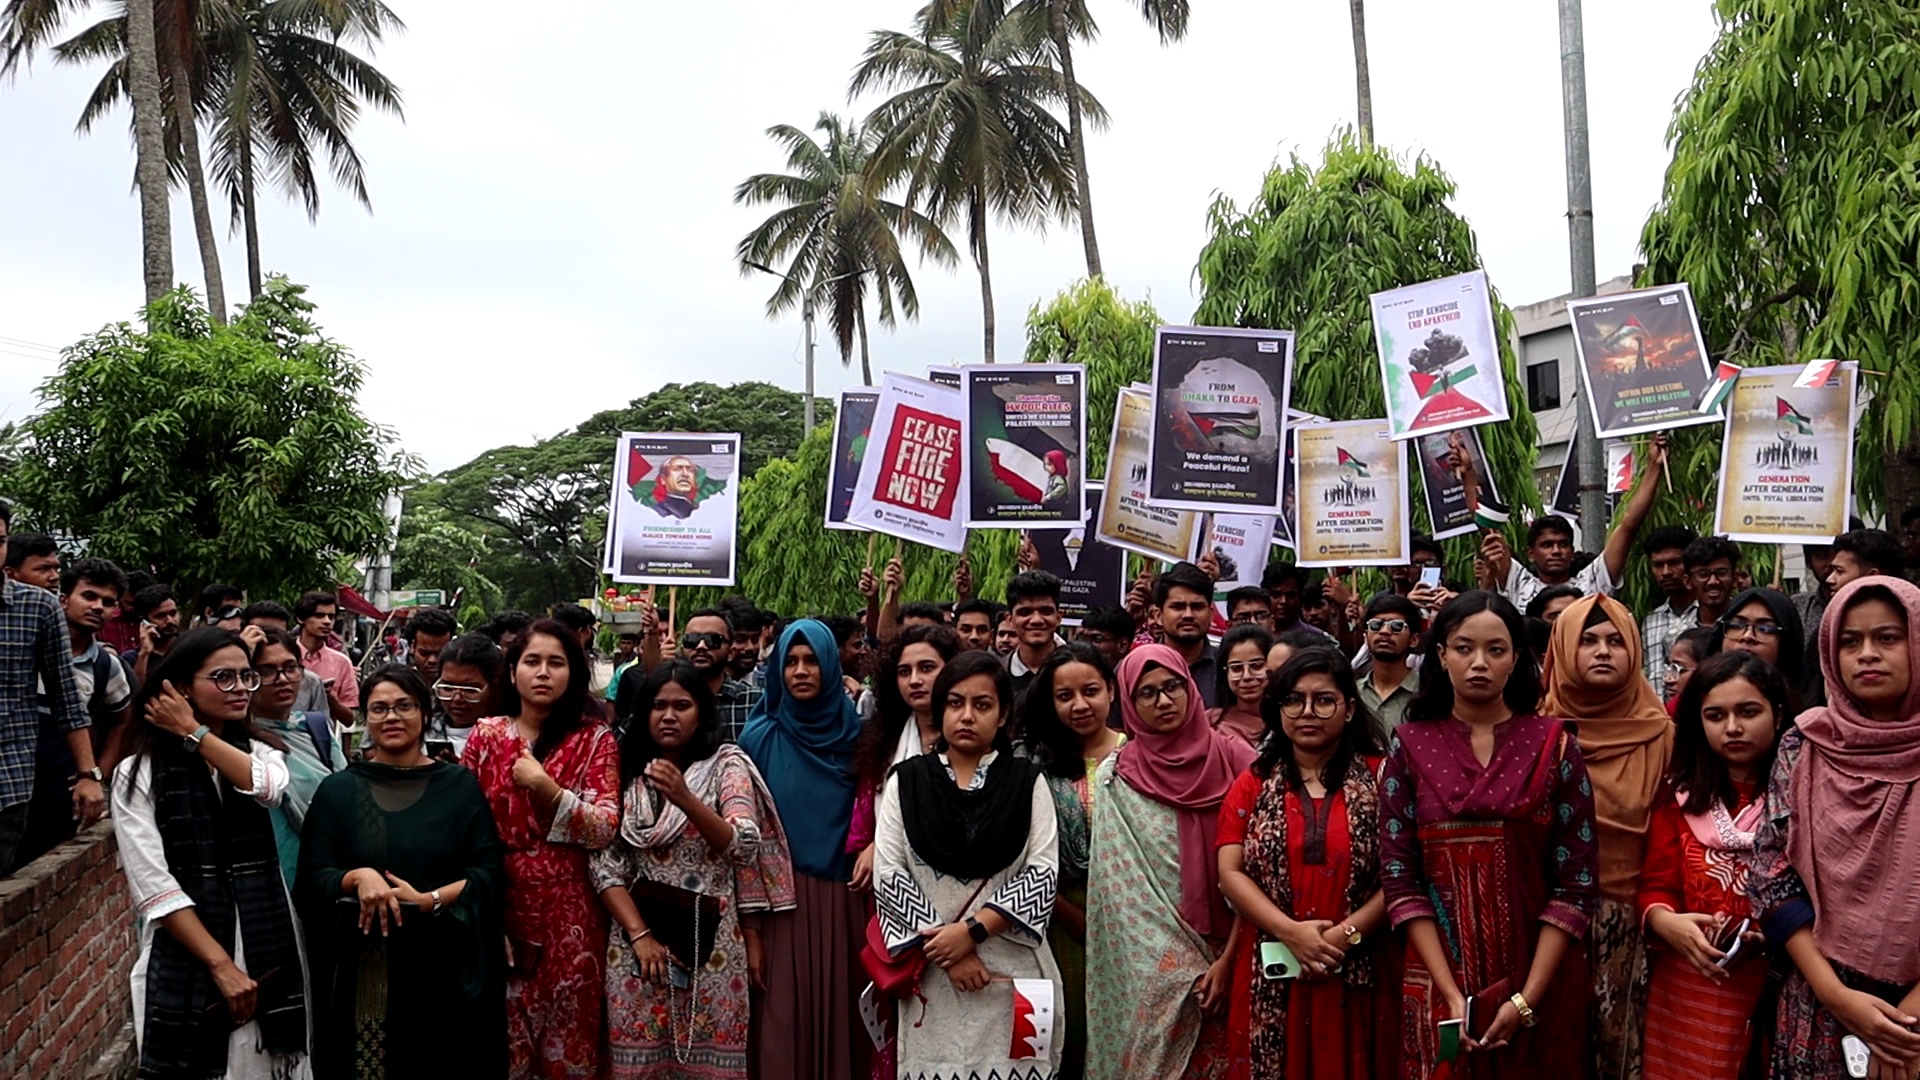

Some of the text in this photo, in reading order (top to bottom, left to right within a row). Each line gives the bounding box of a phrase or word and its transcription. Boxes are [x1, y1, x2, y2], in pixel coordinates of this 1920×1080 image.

[1408, 309, 1424, 319] STOP
[1426, 301, 1458, 314] GENOCIDE
[1409, 312, 1461, 329] END APARTHEID
[1209, 383, 1235, 391] FROM
[1182, 393, 1214, 402] DHAKA
[1641, 395, 1657, 404] FREE
[1658, 390, 1691, 402] PALESTINE
[1006, 402, 1071, 412] HYPOCRITES
[902, 416, 958, 451] CEASE
[895, 439, 952, 483] FIRE
[1202, 453, 1239, 462] demand
[1183, 462, 1220, 471] Peaceful
[887, 472, 944, 510] NOW
[1120, 496, 1138, 507] AFTER
[1217, 524, 1246, 537] GENOCIDE
